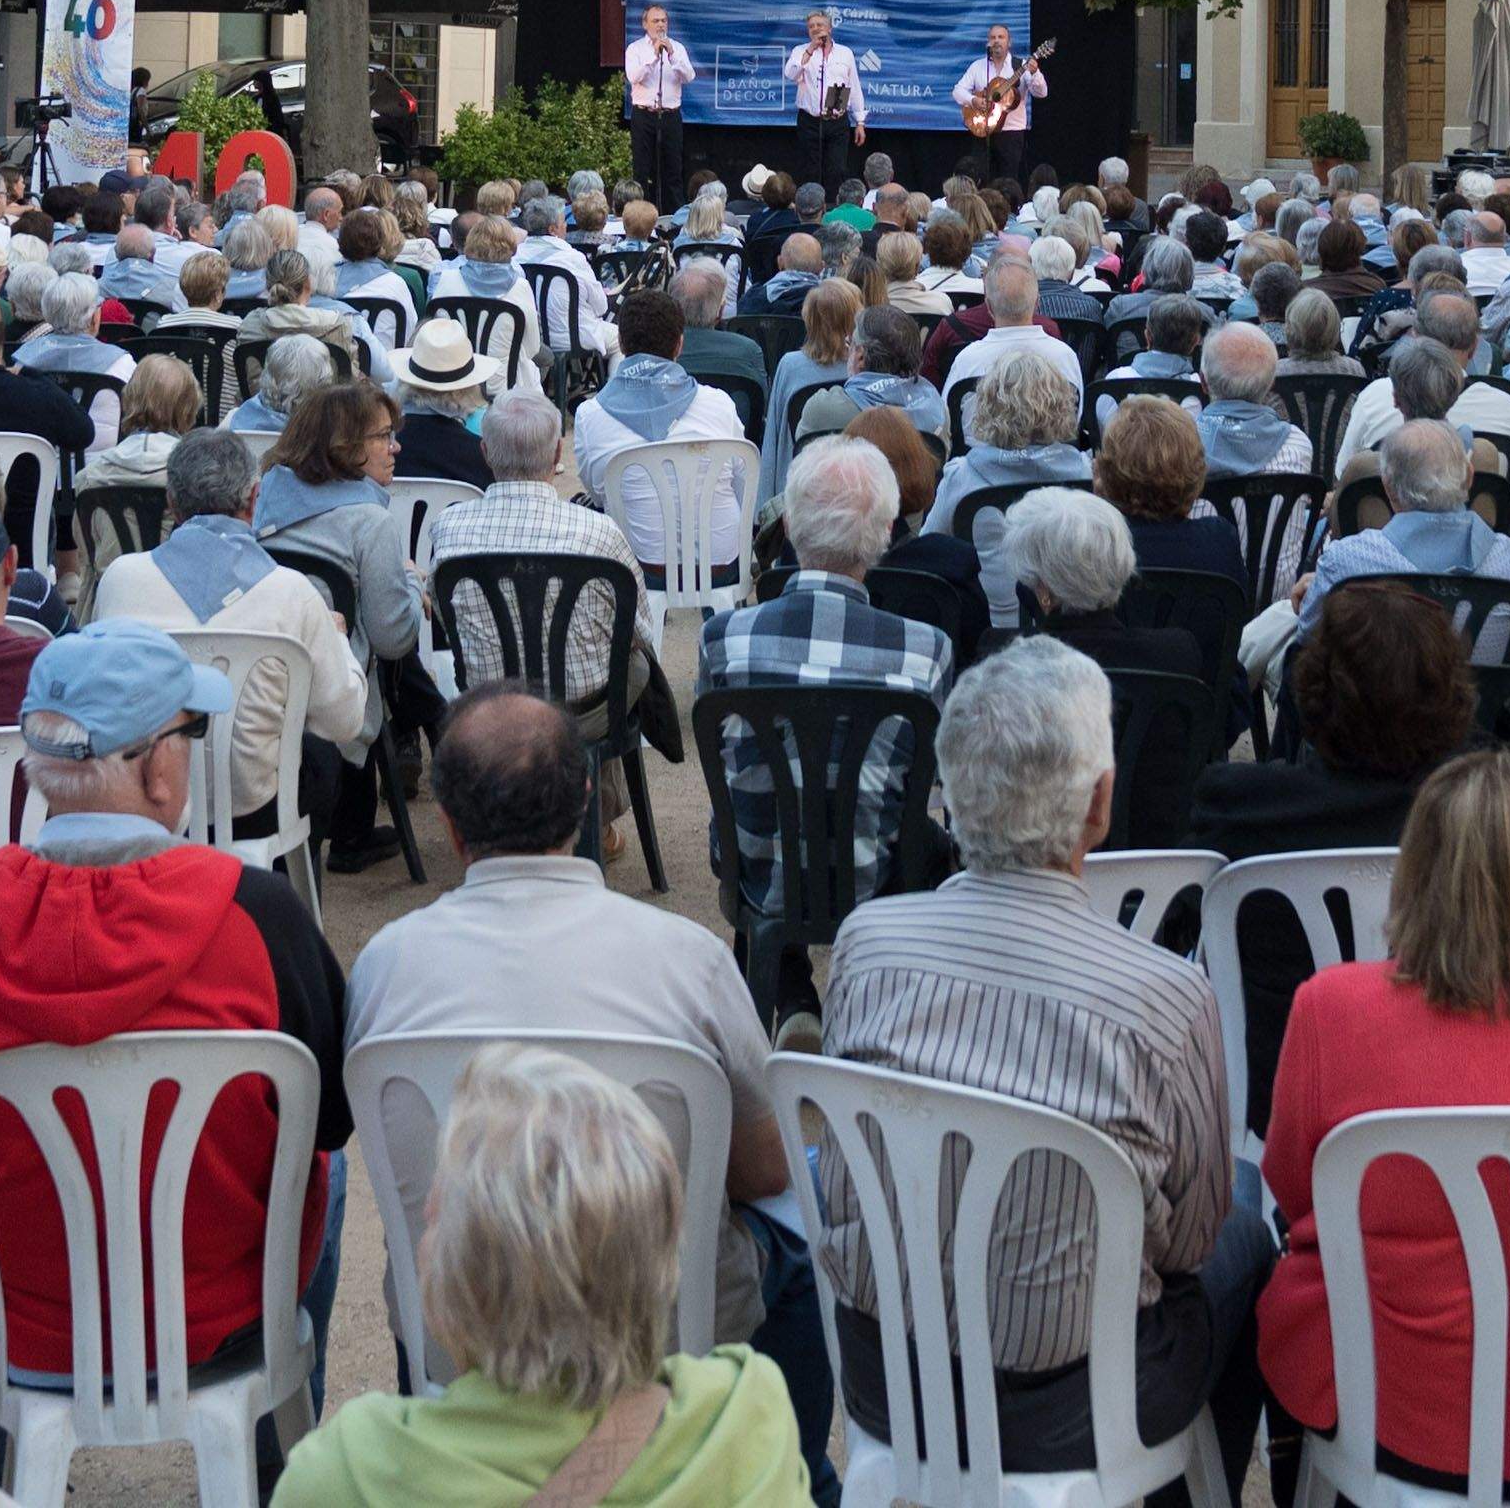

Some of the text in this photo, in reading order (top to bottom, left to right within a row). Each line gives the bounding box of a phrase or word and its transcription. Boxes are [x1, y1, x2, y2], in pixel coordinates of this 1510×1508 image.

[727, 77, 772, 89] BAÑO
[723, 90, 777, 102] DECOR
[868, 84, 933, 97] NATURA
